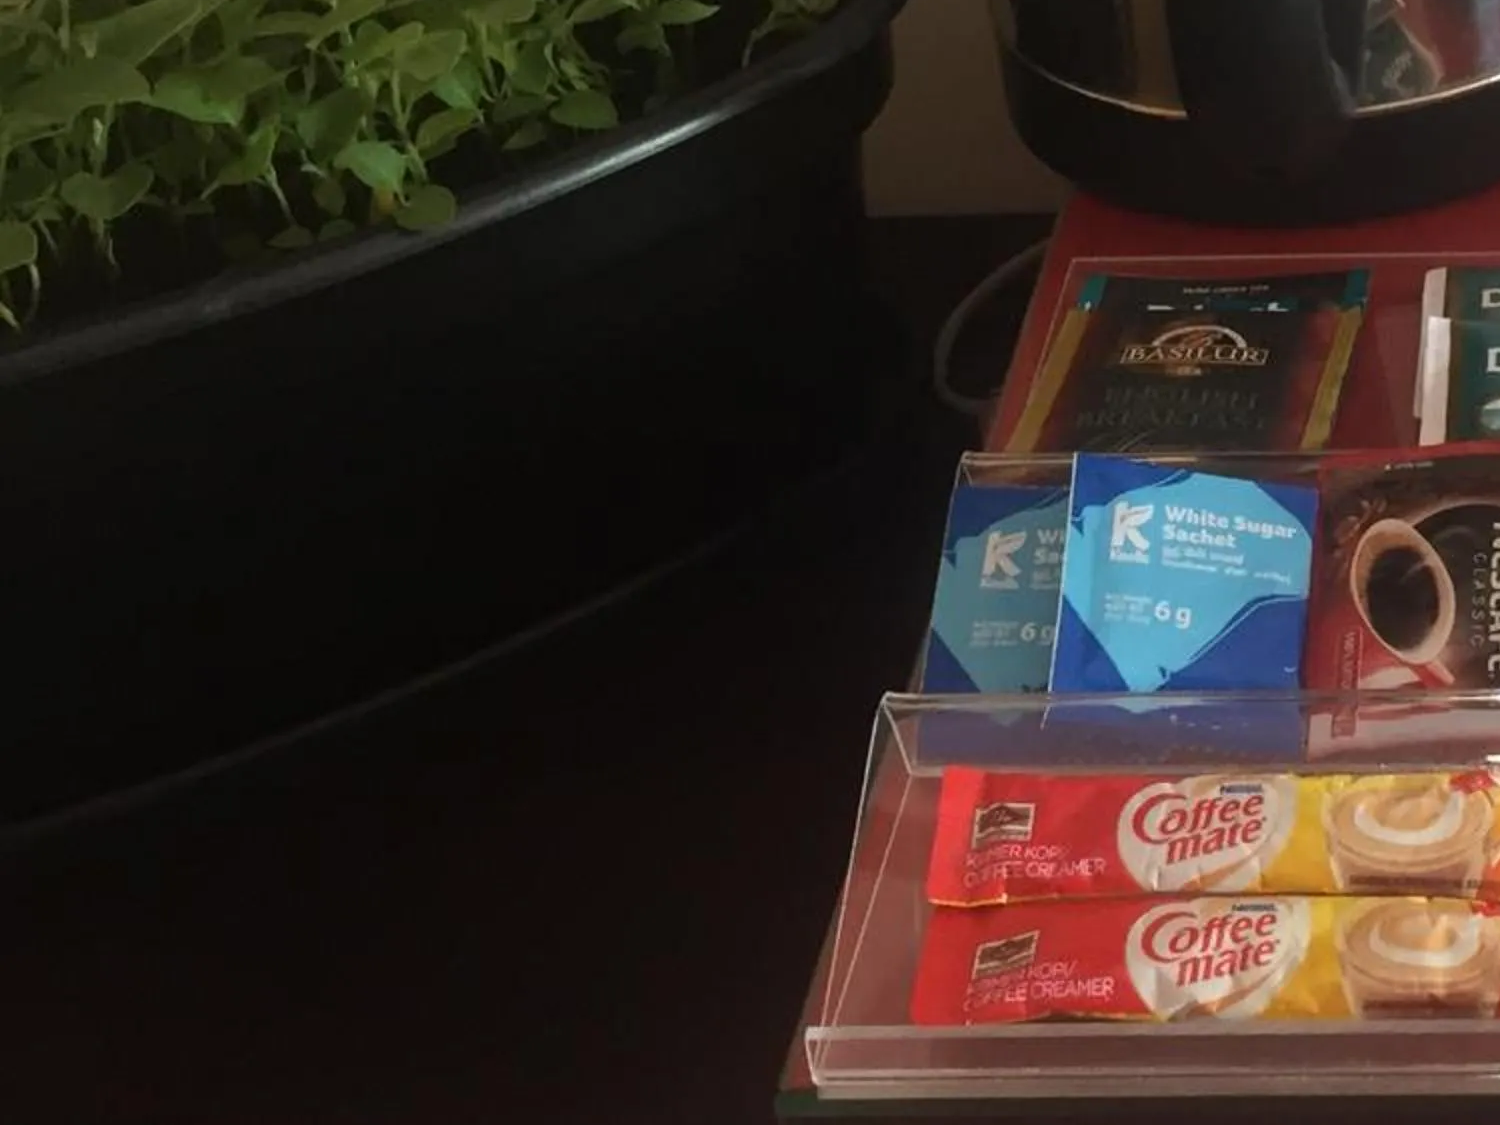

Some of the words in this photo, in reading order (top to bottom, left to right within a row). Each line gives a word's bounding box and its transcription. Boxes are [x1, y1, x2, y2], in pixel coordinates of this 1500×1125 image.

[1163, 524, 1237, 548] Sachet
[1165, 505, 1229, 528] White
[1234, 516, 1297, 539] Sugar
[1154, 600, 1171, 620] 6
[1470, 553, 1487, 650] CLASSIC
[1132, 792, 1264, 845] Coffee
[1165, 819, 1263, 865] mate
[1141, 911, 1278, 963] Coffee
[1176, 940, 1276, 987] mate
[1030, 976, 1115, 1001] CREAMER
